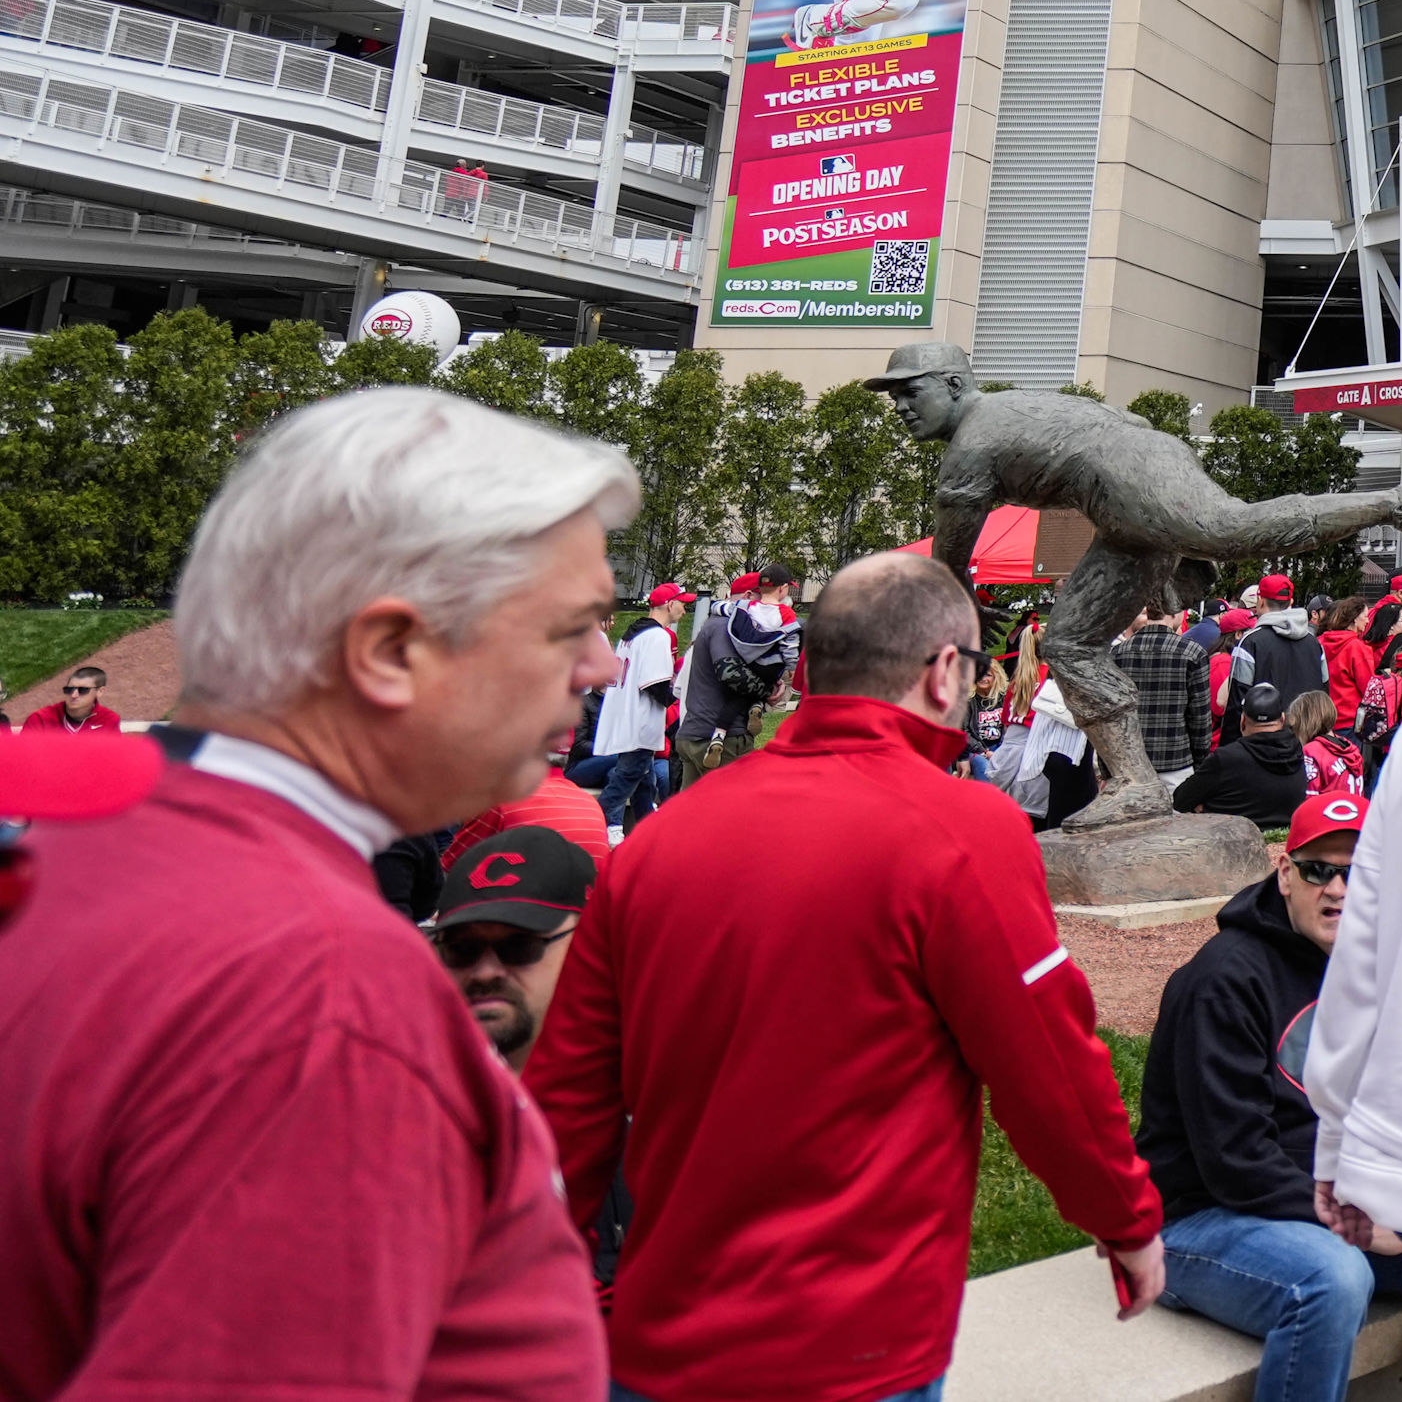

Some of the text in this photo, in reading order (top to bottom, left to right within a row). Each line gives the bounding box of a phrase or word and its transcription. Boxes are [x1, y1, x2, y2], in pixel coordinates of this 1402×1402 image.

[798, 38, 912, 61] STARTING AT 13 GAMES
[764, 69, 936, 108] TICKET PLANS
[790, 59, 900, 88] FLEXIBLE
[796, 97, 924, 129] EXCLUSIVE
[770, 118, 892, 149] BENEFITS
[772, 165, 904, 205] OPENING DAY
[762, 210, 909, 248] POSTSEASON
[725, 279, 858, 292] (513) 381-REDS
[372, 320, 411, 331] REDS
[1337, 389, 1359, 404] GATE
[1361, 385, 1371, 405] A
